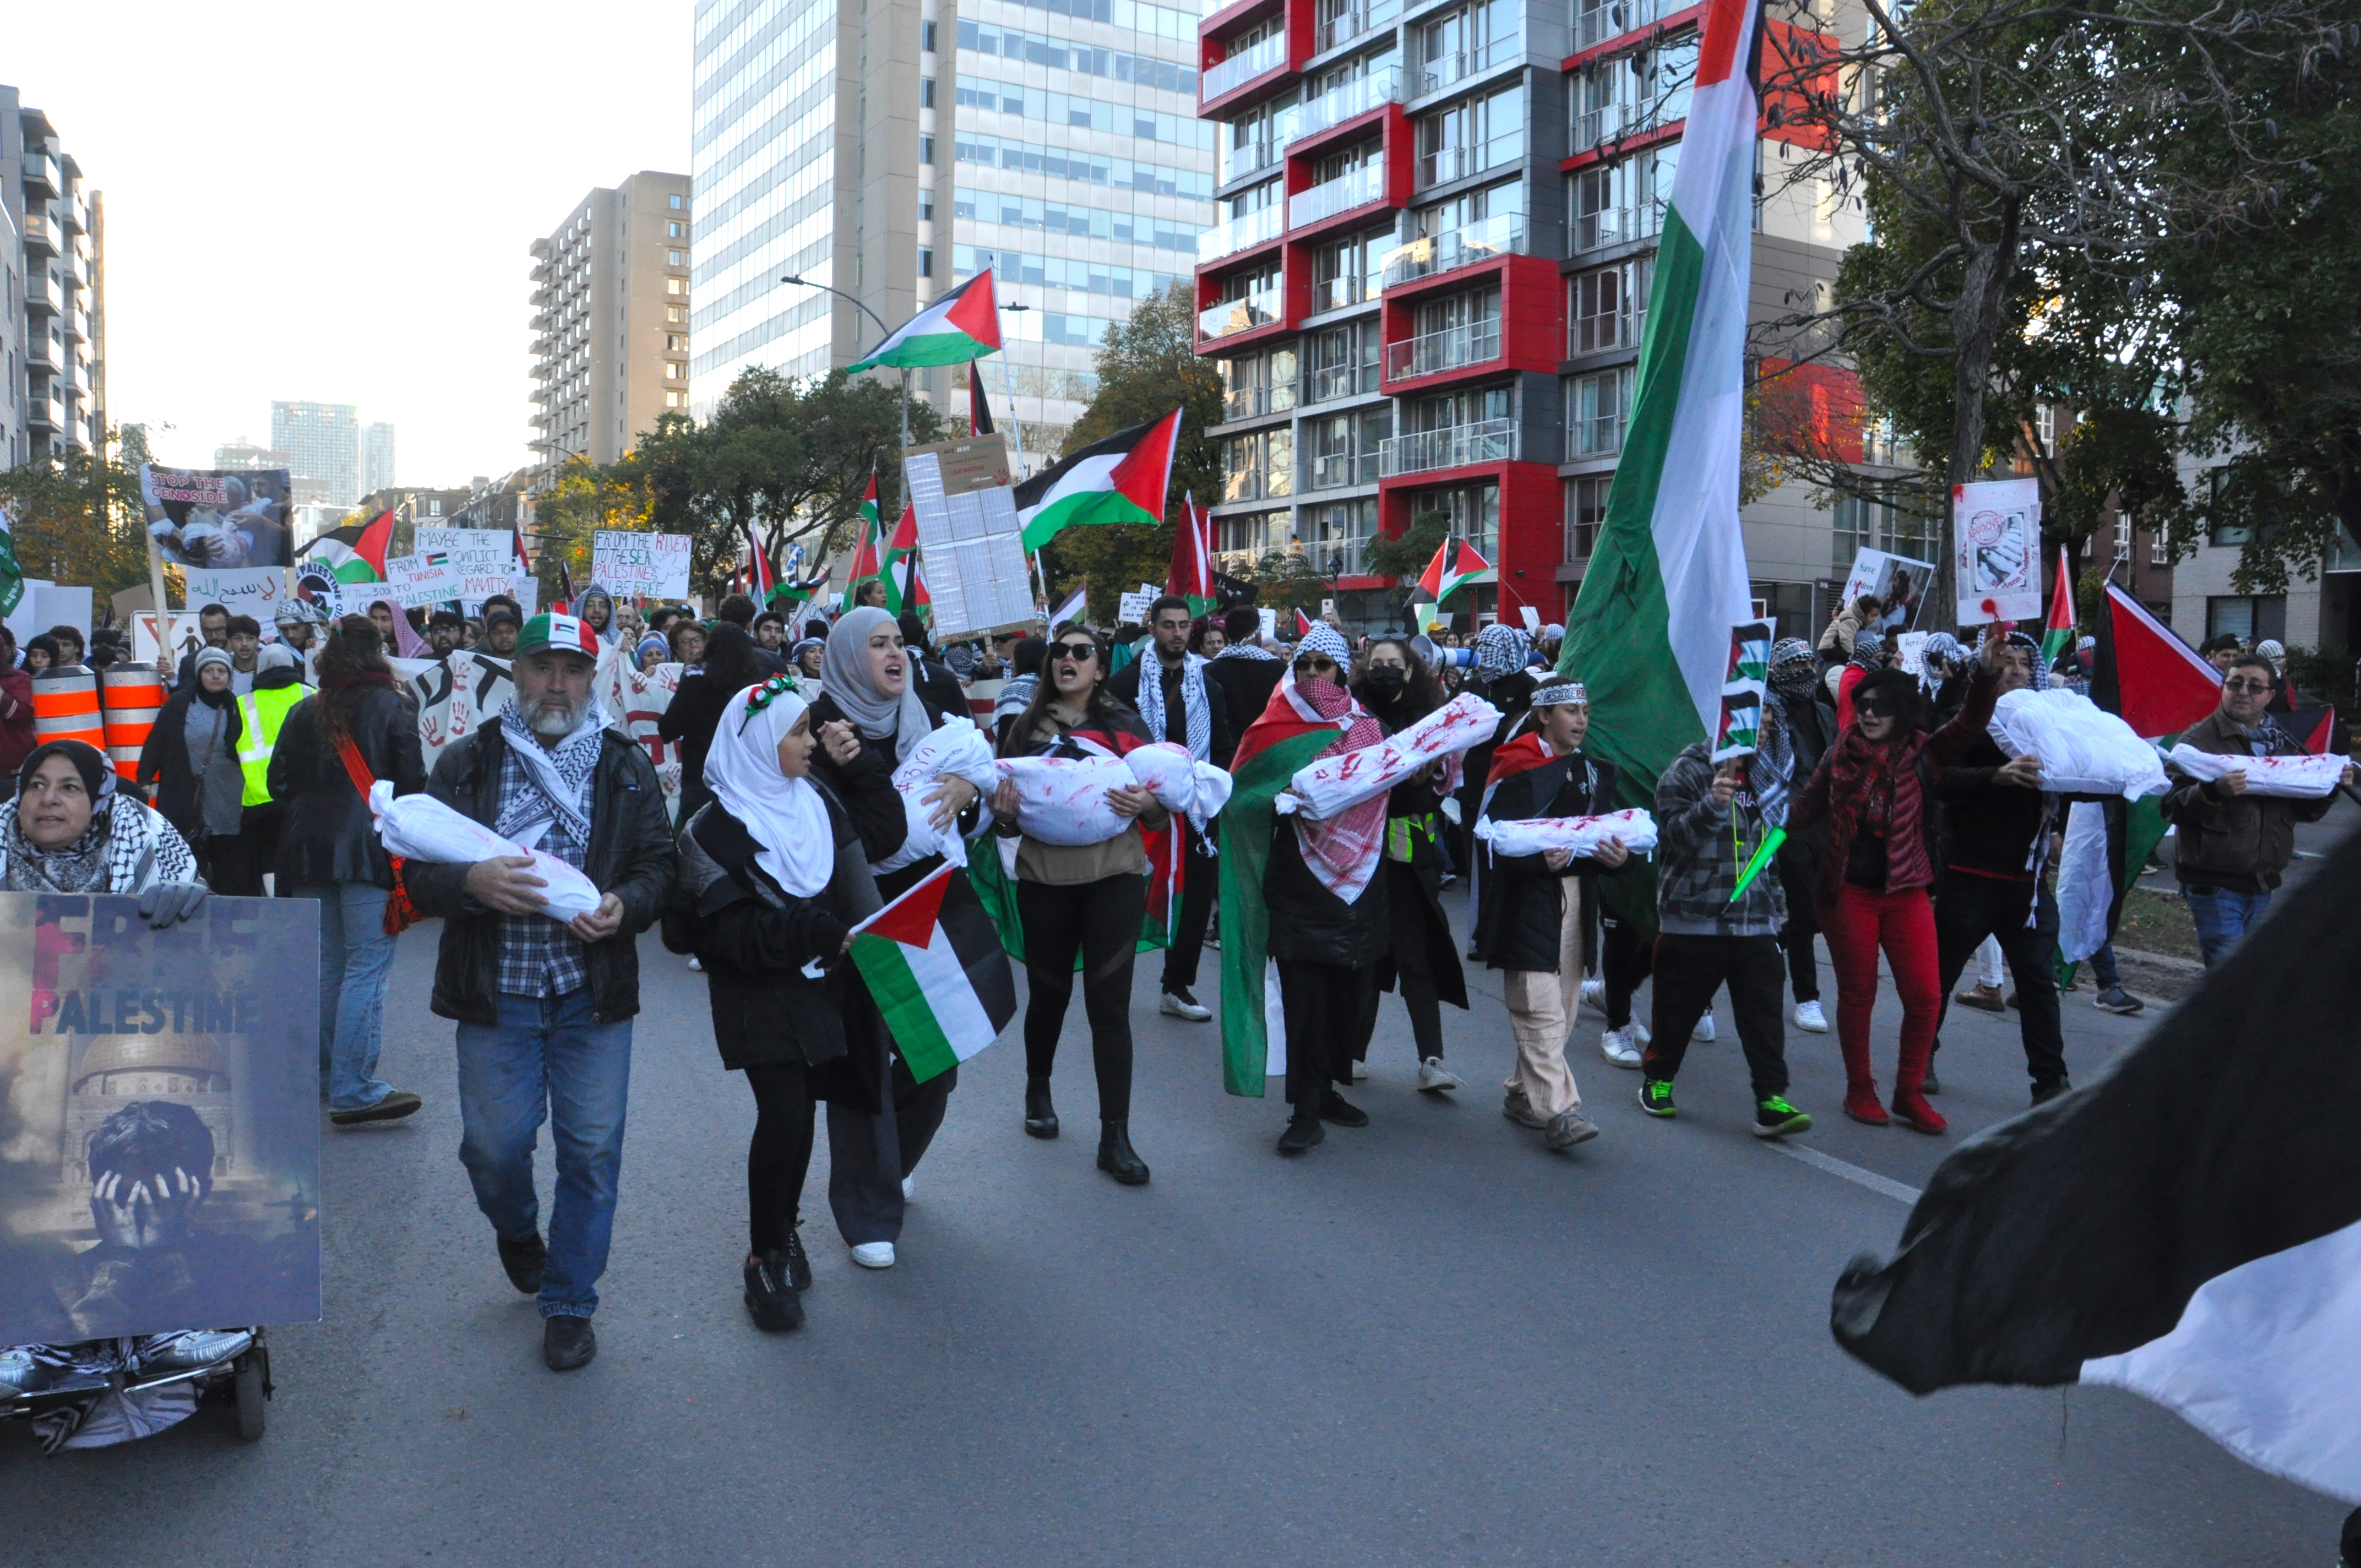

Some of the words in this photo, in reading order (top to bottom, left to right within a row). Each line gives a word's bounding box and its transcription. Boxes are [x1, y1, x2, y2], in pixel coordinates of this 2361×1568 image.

[956, 445, 970, 453] JUST
[150, 471, 189, 488] STOP
[193, 476, 226, 489] THE
[151, 487, 229, 504] GENOSIDE
[1968, 515, 2005, 540] APPROVED
[418, 532, 460, 548] MAYBE
[469, 533, 491, 546] THE
[596, 531, 628, 548] FROM
[631, 533, 652, 549] THE
[656, 533, 692, 552] RIVER
[454, 550, 499, 563] ONFLICT
[594, 548, 608, 563] TO
[610, 548, 629, 564] THE
[629, 549, 651, 565] SEA
[388, 558, 420, 574] FROM
[498, 564, 511, 575] TO
[592, 563, 653, 580] PALESTINE
[1858, 562, 1876, 574] Save
[300, 563, 342, 601] PALESTINE
[406, 568, 444, 582] TUNISIA
[1991, 579, 1999, 589] By
[2001, 576, 2021, 589] Justin
[192, 578, 219, 597] الله
[257, 575, 276, 601] لا
[373, 587, 391, 597] 300
[394, 583, 411, 594] TO
[614, 580, 631, 595] BE
[634, 581, 665, 596] FREE
[1849, 579, 1874, 591] Chdren
[396, 584, 461, 607] PALESTINE
[1544, 688, 1587, 702] #SAVEPA
[33, 895, 260, 989] FREE
[30, 989, 259, 1035] PALESTINE
